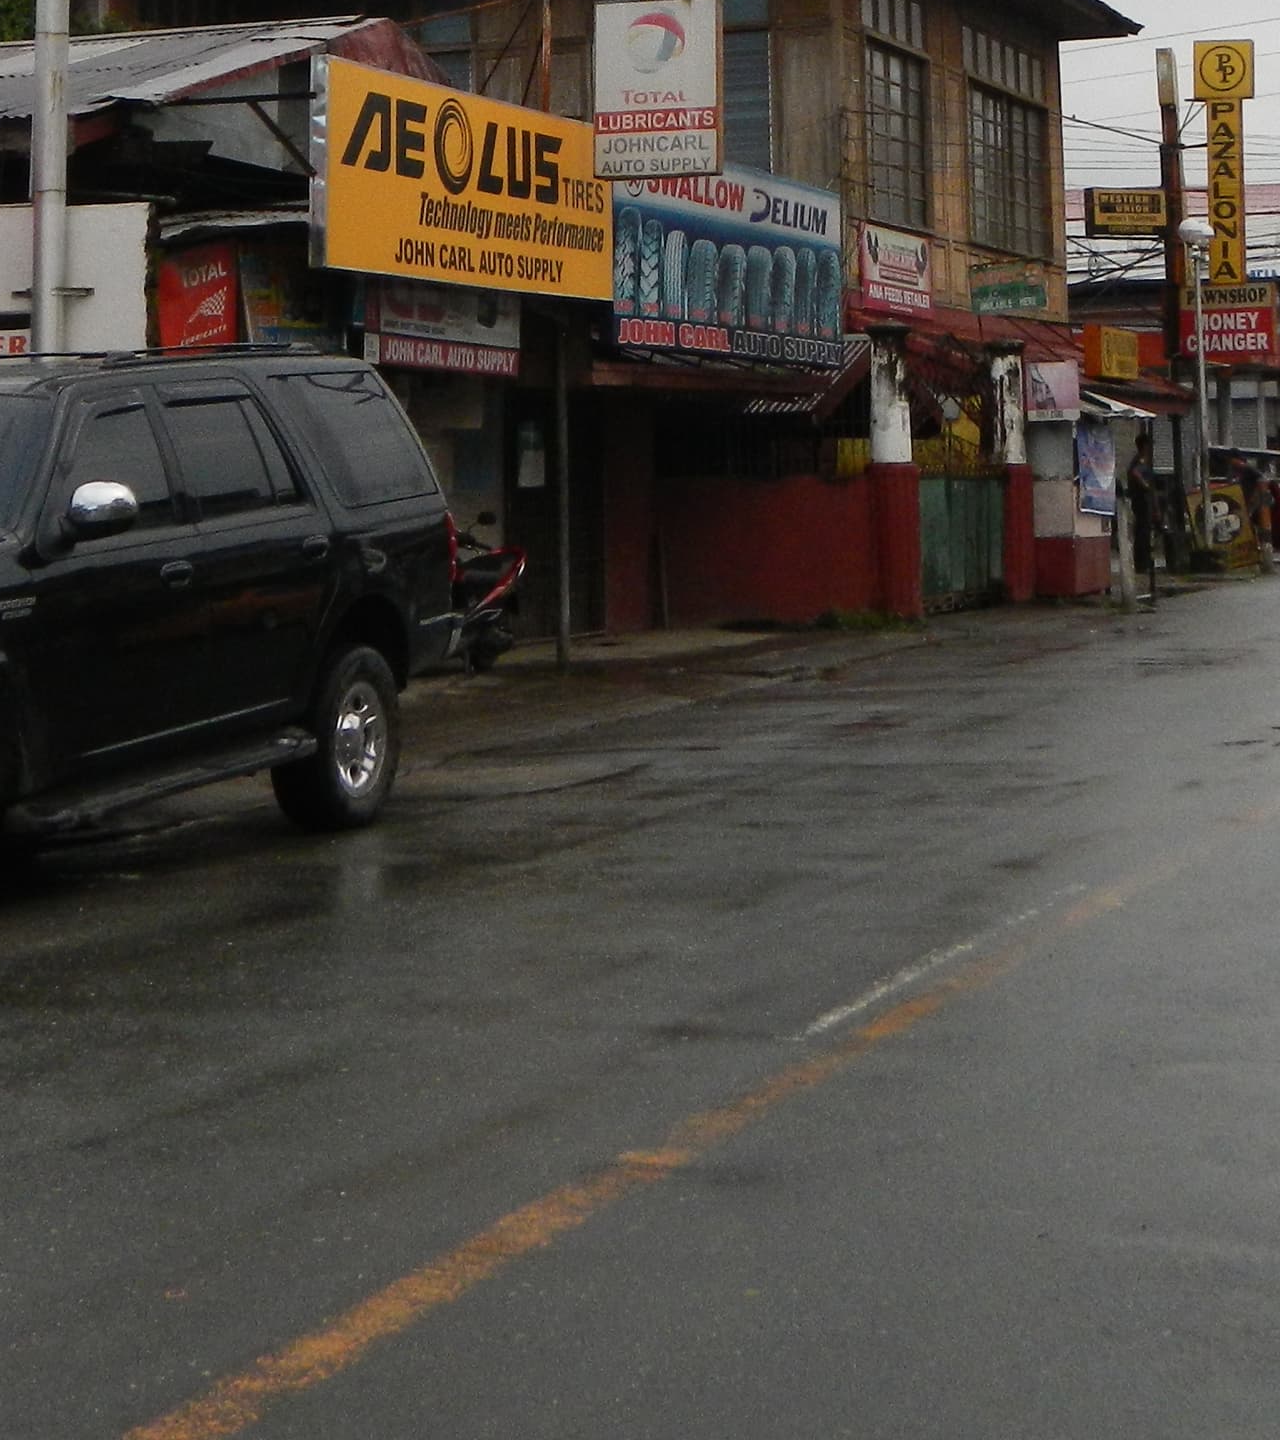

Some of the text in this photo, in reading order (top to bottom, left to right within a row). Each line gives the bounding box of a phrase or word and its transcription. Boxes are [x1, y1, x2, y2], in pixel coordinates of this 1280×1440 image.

[621, 88, 688, 106] TOTAL
[598, 110, 715, 131] LUBRICANTS
[601, 157, 711, 174] AUTO SUPPLY
[562, 181, 605, 215] TIRES
[646, 176, 745, 212] SWALLOW
[1211, 102, 1239, 281] PAZALONIA
[1115, 204, 1150, 214] UNION
[418, 192, 605, 254] Technology meets Performance
[395, 237, 564, 284] JOHN CARL AUTO SUPPLY
[182, 261, 228, 288] TOTAL
[1186, 286, 1268, 305] PAWNSHOP
[1194, 311, 1260, 332] MONEY
[618, 318, 843, 365] JOHN CARL AUTO SUPPLY
[1186, 332, 1269, 352] CHANGER
[386, 338, 518, 373] JOHN CARL AUTO SUPPLY
